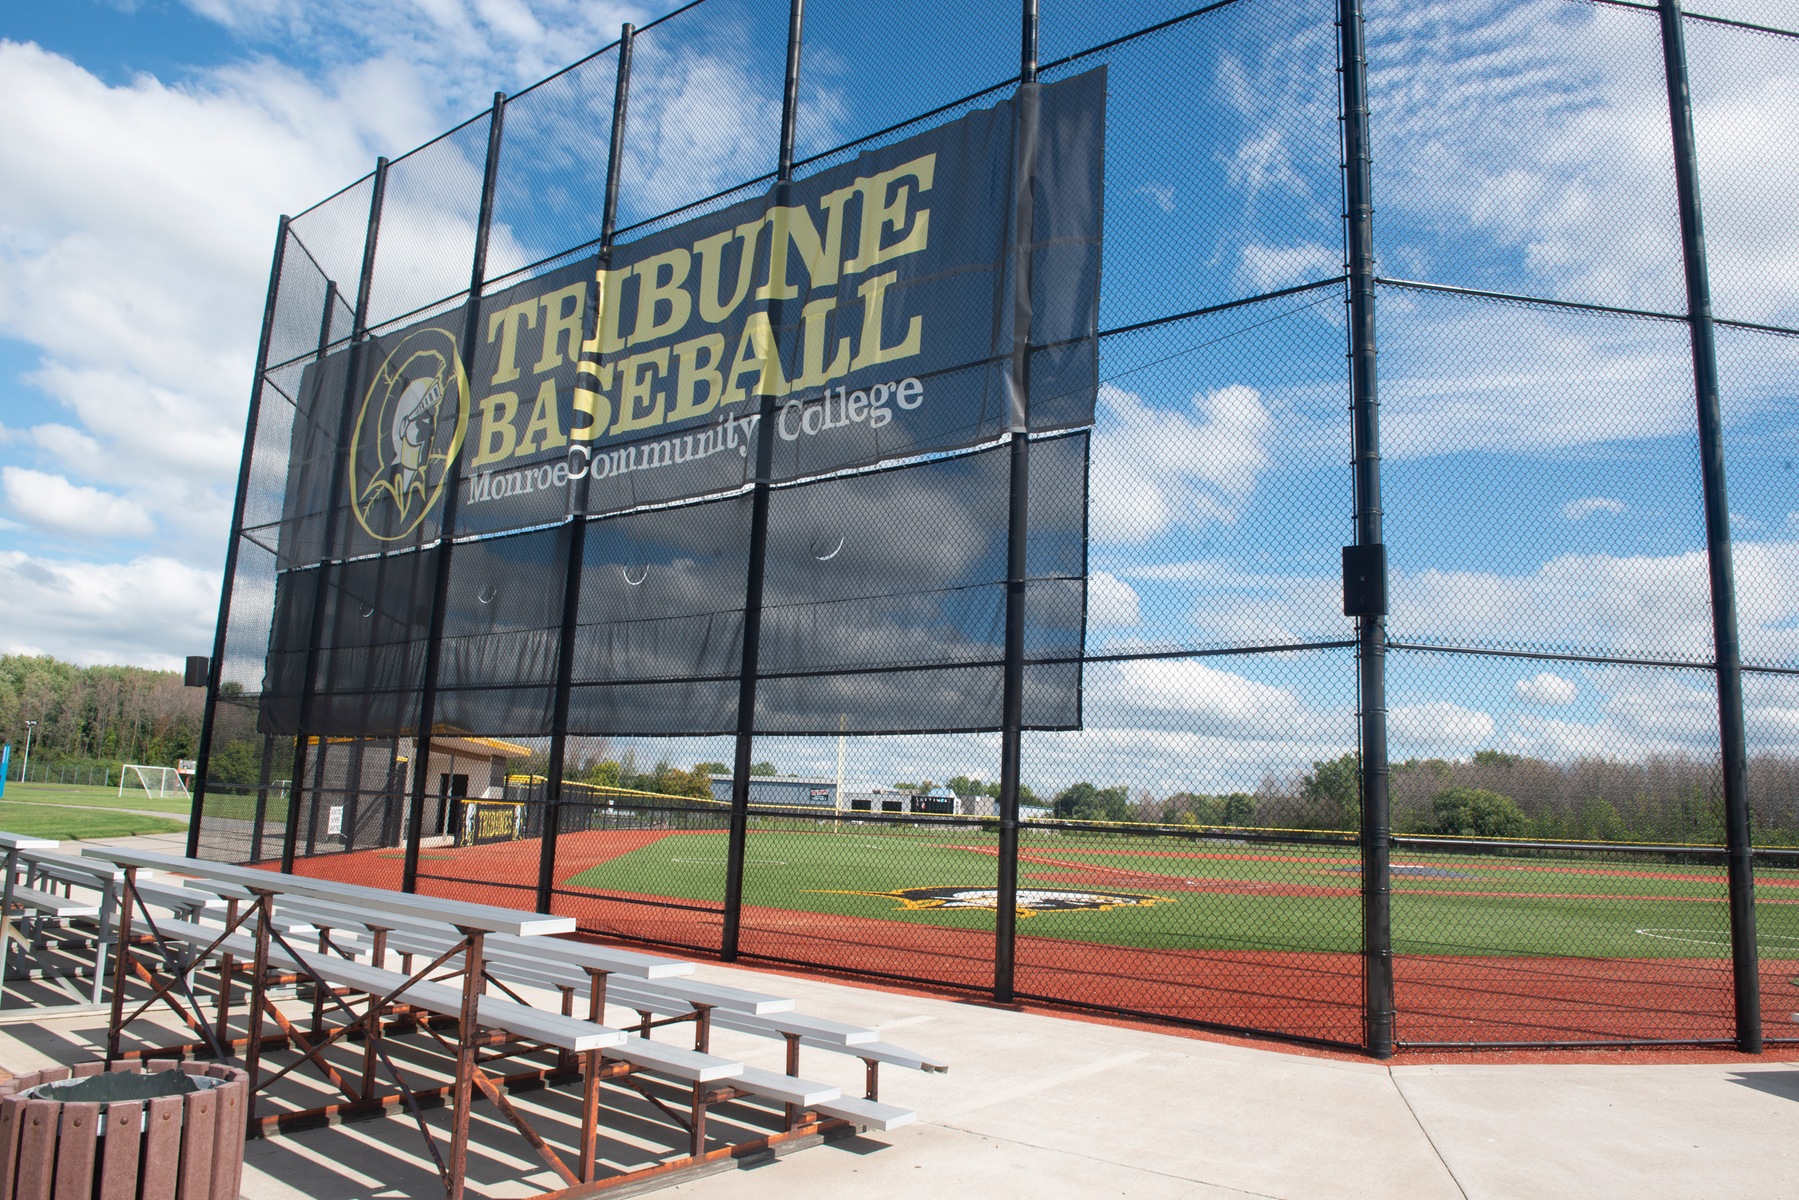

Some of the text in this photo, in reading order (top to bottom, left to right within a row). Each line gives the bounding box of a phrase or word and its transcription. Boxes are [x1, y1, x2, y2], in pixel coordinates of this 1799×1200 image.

[487, 153, 937, 386] TRIBUNE
[467, 377, 924, 505] Monroe Community College
[471, 270, 923, 467] BASEBALL
